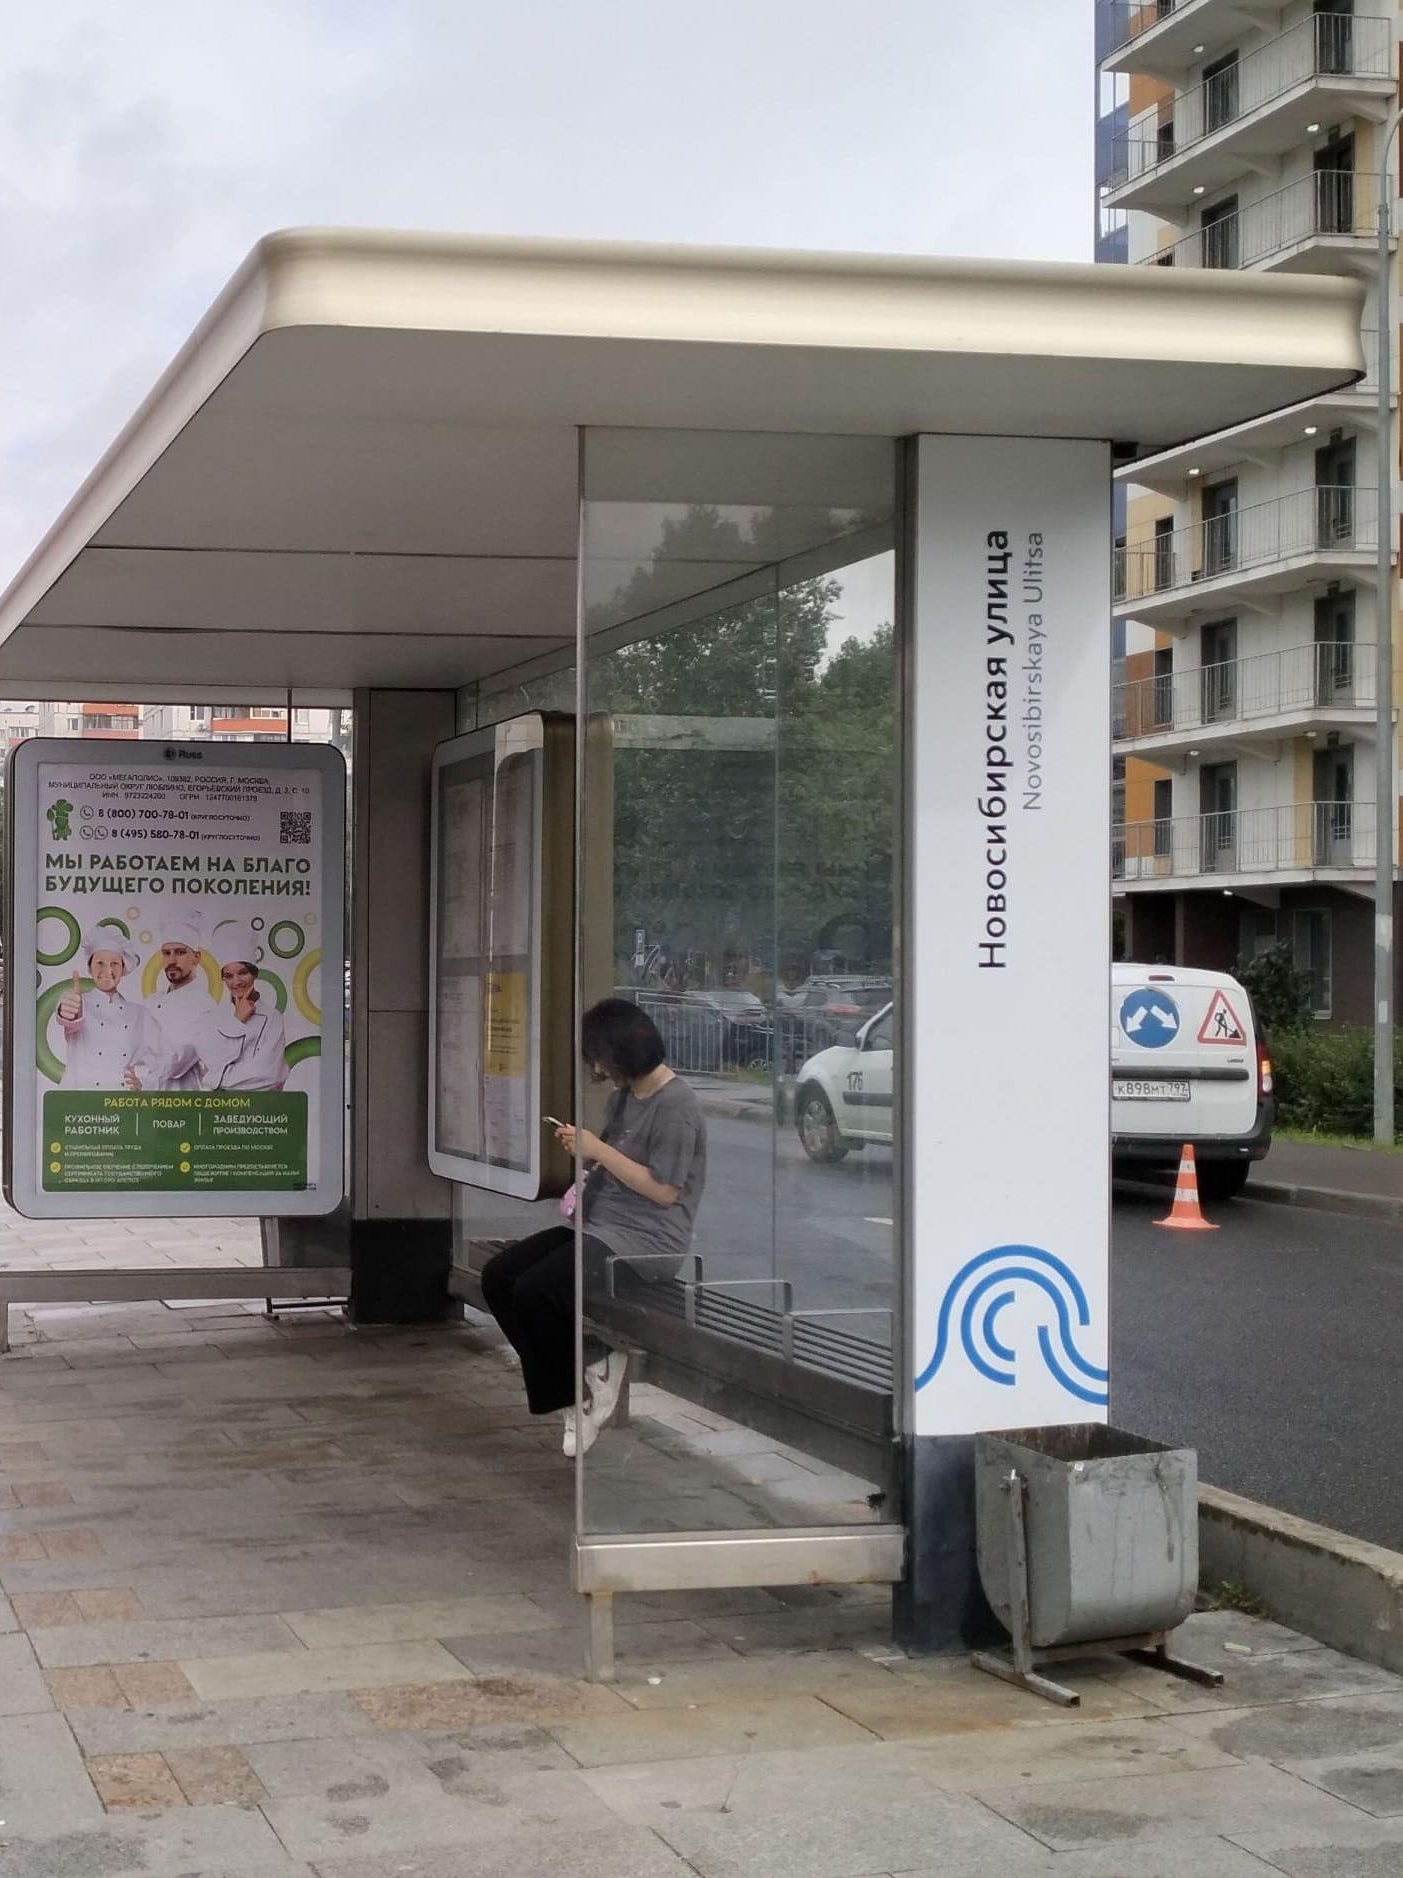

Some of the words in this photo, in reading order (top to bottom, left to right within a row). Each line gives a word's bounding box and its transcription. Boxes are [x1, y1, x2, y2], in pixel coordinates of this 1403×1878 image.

[1022, 532, 1044, 603] Ulitsa
[986, 530, 1015, 645] улица
[1022, 613, 1047, 810] Novosibirskaya
[98, 808, 104, 817] 8
[107, 808, 136, 819] (800)
[139, 810, 189, 819] 700-78-01
[978, 656, 1014, 969] Новосибирская
[111, 830, 117, 838] 8
[120, 829, 147, 839] (495)
[150, 830, 199, 839] 580-78-01
[46, 853, 82, 869] МЫ
[90, 854, 199, 871] РАБОТАЕМ
[207, 857, 236, 872] НА
[243, 857, 311, 873] БЛАГО
[46, 876, 164, 894] БУДУЩЕГО
[172, 878, 311, 896] ПОКОЛЕНИЯ!
[846, 1071, 863, 1090] 176
[104, 1098, 149, 1107] РАБОТА
[151, 1098, 192, 1108] РЯДОМ
[194, 1098, 202, 1107] С
[204, 1098, 251, 1107] ДОМОМ
[64, 1113, 120, 1123] КУХОННЫЙ
[213, 1113, 288, 1124] ЗАВЕДУЮЩИЙ
[152, 1120, 186, 1128] ПОВАР
[64, 1126, 120, 1135] РАБОТНИК
[213, 1126, 288, 1135] ПРОИЗВОДСТВОМ
